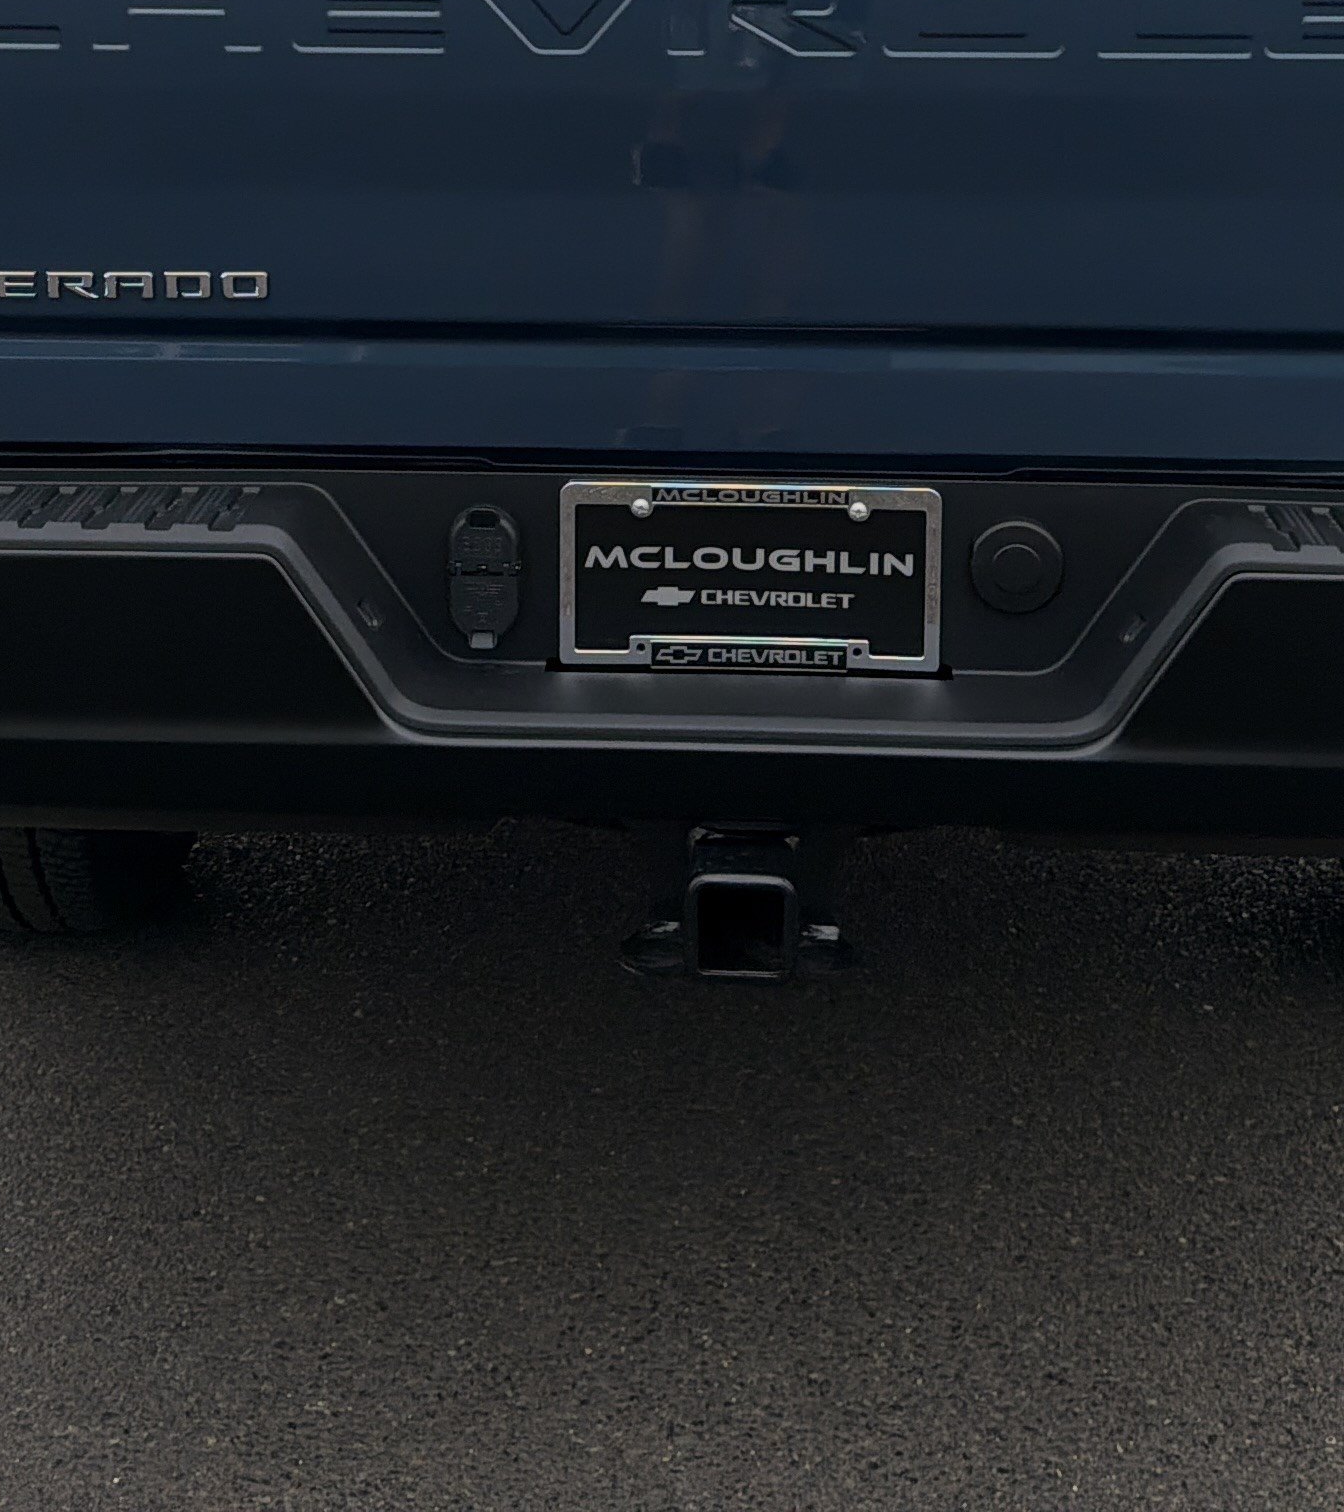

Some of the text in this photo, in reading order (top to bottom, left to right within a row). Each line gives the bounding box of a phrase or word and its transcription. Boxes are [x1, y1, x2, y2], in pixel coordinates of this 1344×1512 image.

[656, 489, 847, 505] MCLOUGHLIN
[584, 546, 914, 577] MCLOUGHLIN
[701, 589, 855, 610] CHEVROLET
[708, 648, 844, 666] CHEVROLET
